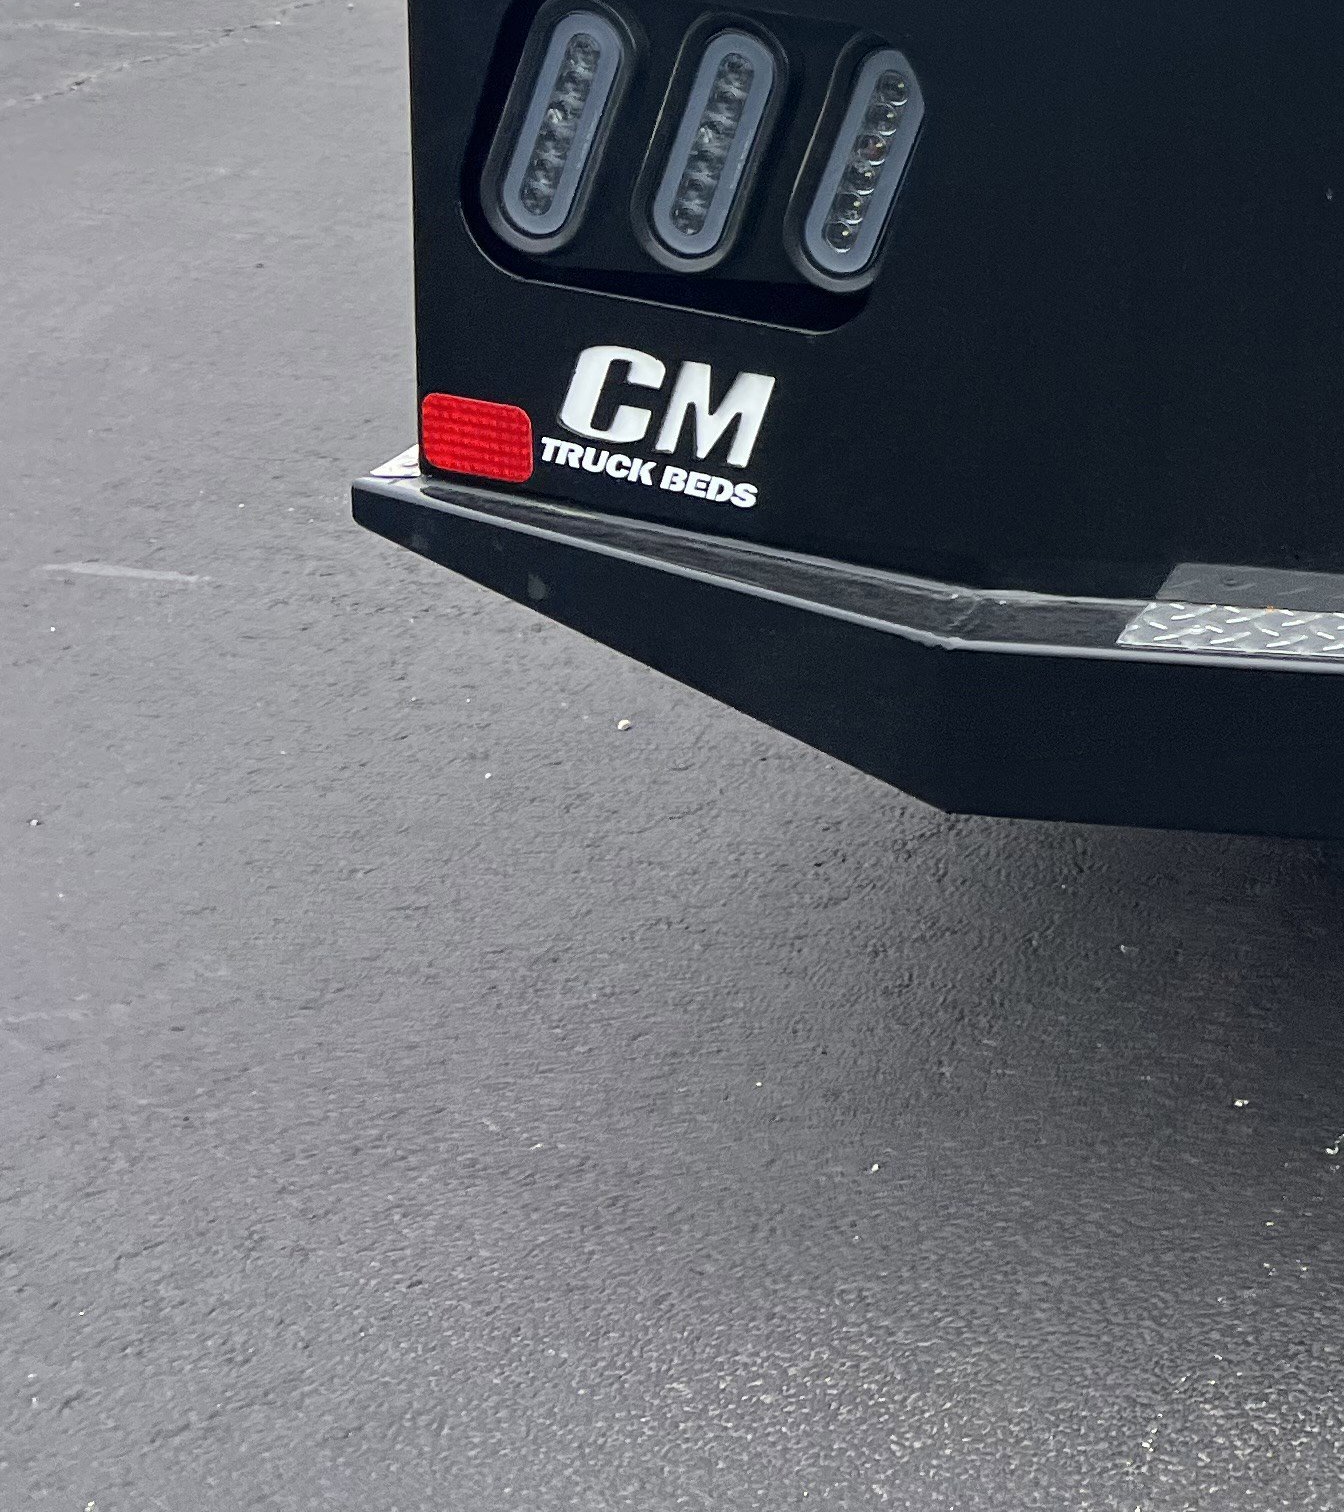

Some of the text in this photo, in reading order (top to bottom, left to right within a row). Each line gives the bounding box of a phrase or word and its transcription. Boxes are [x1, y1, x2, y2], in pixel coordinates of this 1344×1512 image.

[556, 345, 777, 469] CM
[541, 437, 759, 509] TRUCK BEDS
